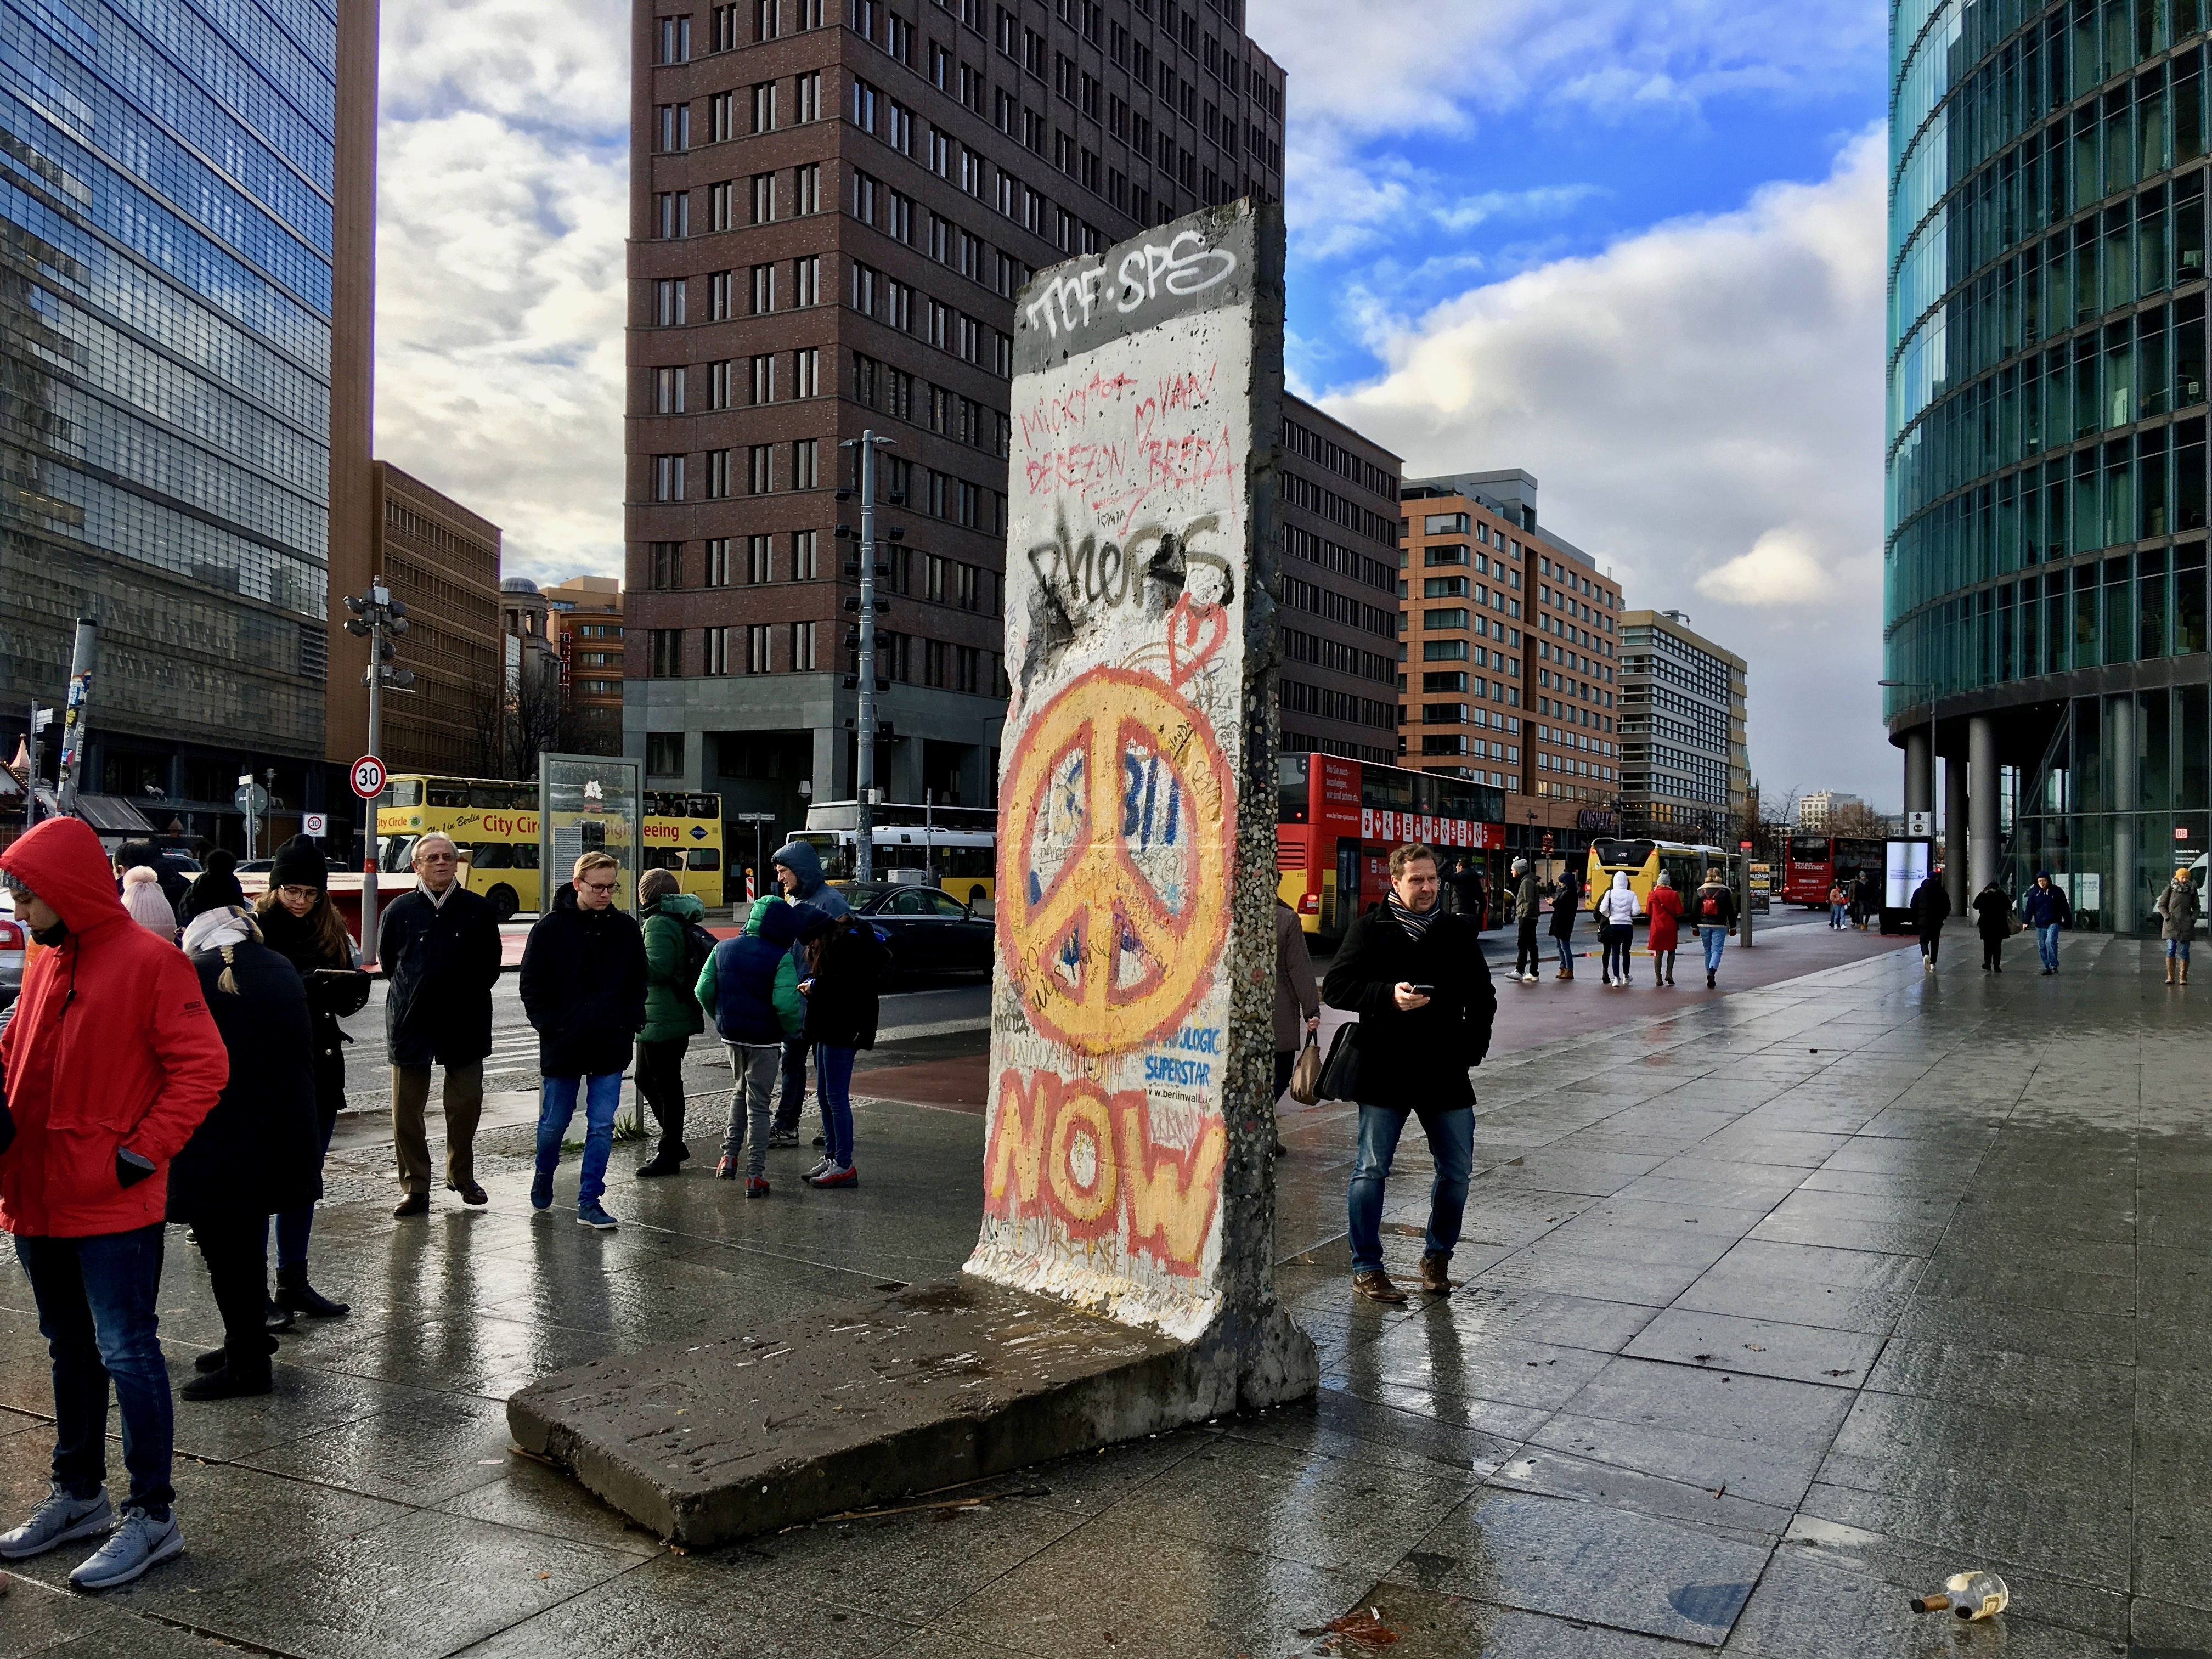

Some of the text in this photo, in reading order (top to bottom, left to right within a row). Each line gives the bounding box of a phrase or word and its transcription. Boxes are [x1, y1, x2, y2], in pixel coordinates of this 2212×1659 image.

[358, 767, 379, 786] 30
[388, 817, 407, 827] Circle
[456, 813, 481, 827] Berlin
[483, 815, 513, 837] City
[1794, 862, 1825, 870] Höffner
[1145, 1054, 1211, 1087] SUPERSTAR
[984, 1068, 1229, 1277] NOW
